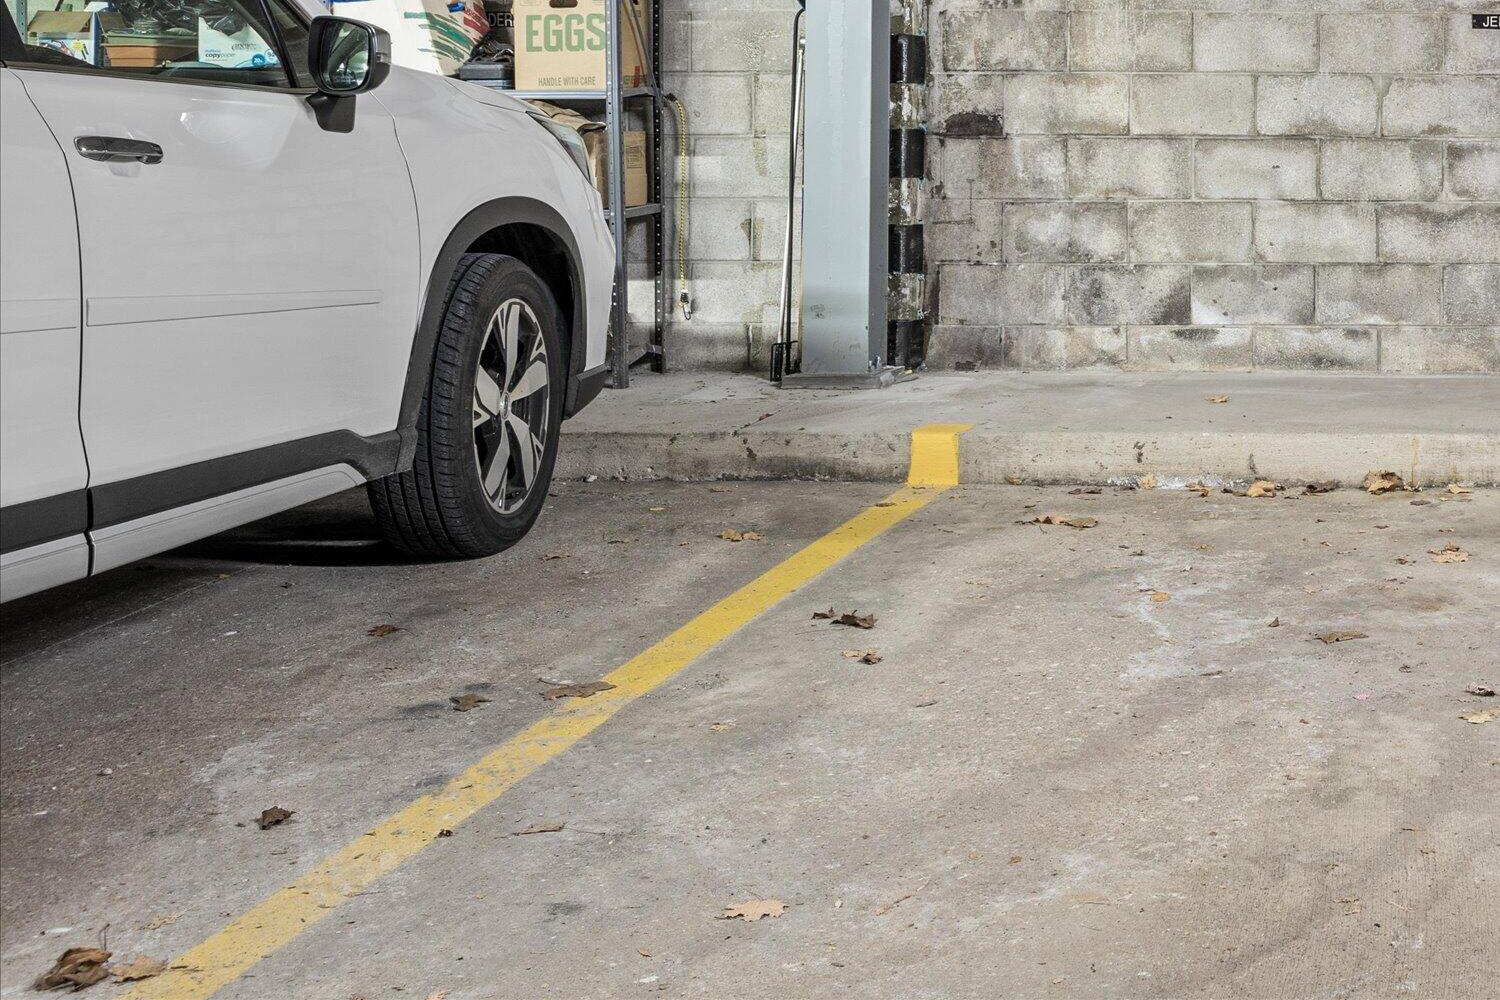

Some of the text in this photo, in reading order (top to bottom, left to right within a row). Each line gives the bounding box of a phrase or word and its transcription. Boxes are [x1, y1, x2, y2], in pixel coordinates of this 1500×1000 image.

[525, 13, 606, 53] EGGS
[538, 76, 596, 86] HANDLE WITH CARE
